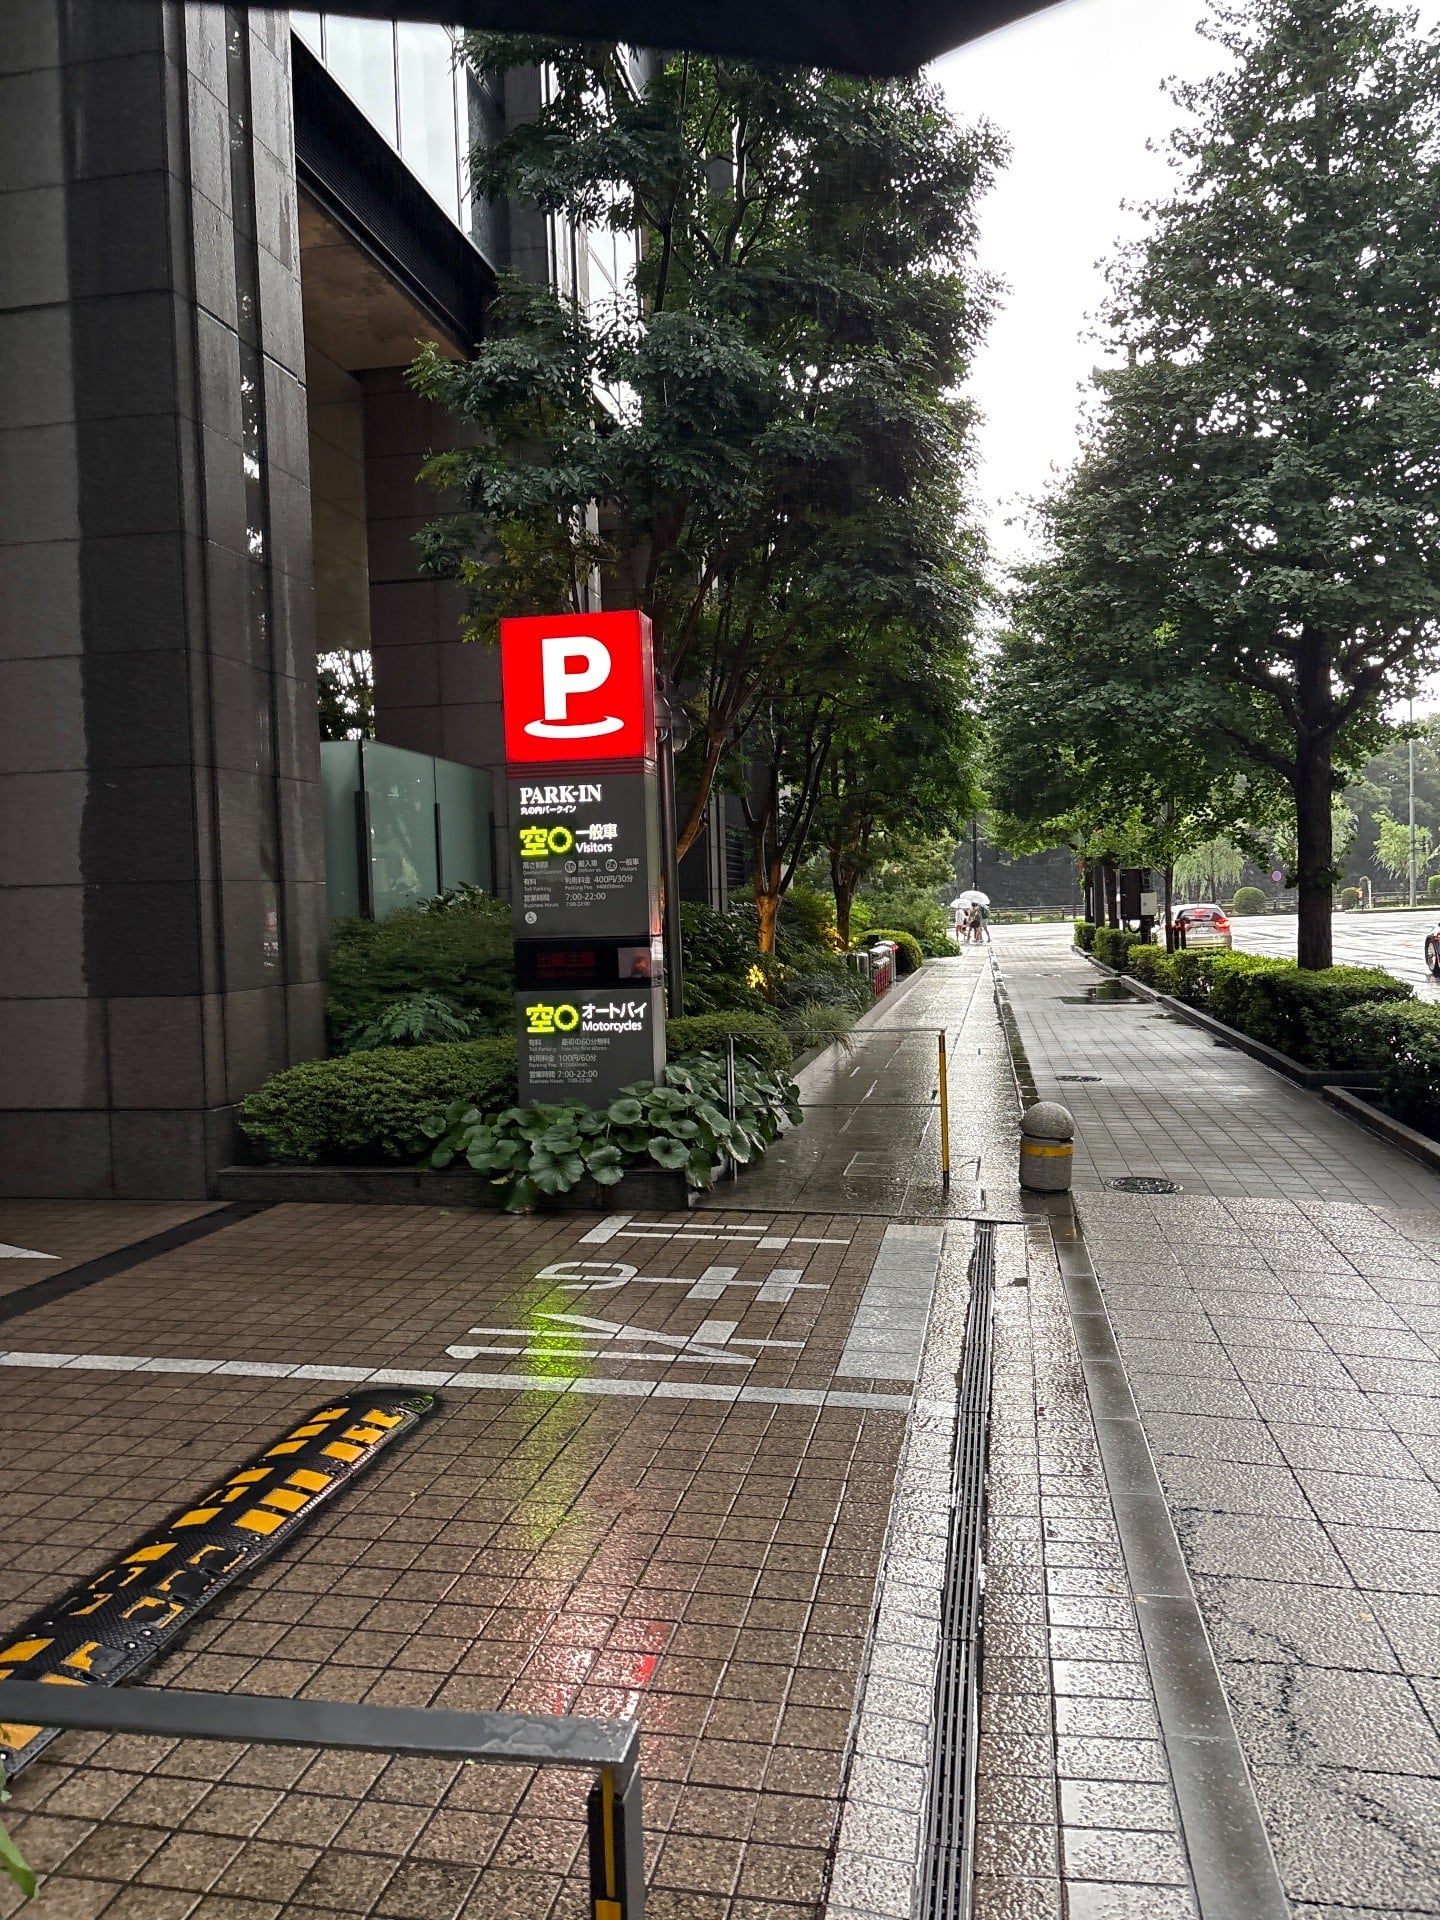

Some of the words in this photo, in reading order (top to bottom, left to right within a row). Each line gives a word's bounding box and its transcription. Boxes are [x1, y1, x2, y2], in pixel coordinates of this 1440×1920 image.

[541, 636, 611, 720] P
[519, 784, 602, 805] PARK-IN
[520, 805, 577, 815] 丸の内パークイン
[575, 823, 618, 840] 一般車
[575, 842, 613, 853] Visitors
[619, 858, 639, 866] 一般車
[594, 875, 634, 884] 400円/30分
[565, 892, 606, 901] 7:00-22:00
[581, 1001, 648, 1020] オートバイ
[582, 1020, 643, 1034] Motorcycles
[558, 1054, 597, 1062] 100円/60分
[557, 1070, 598, 1078] 7:00-22:00
